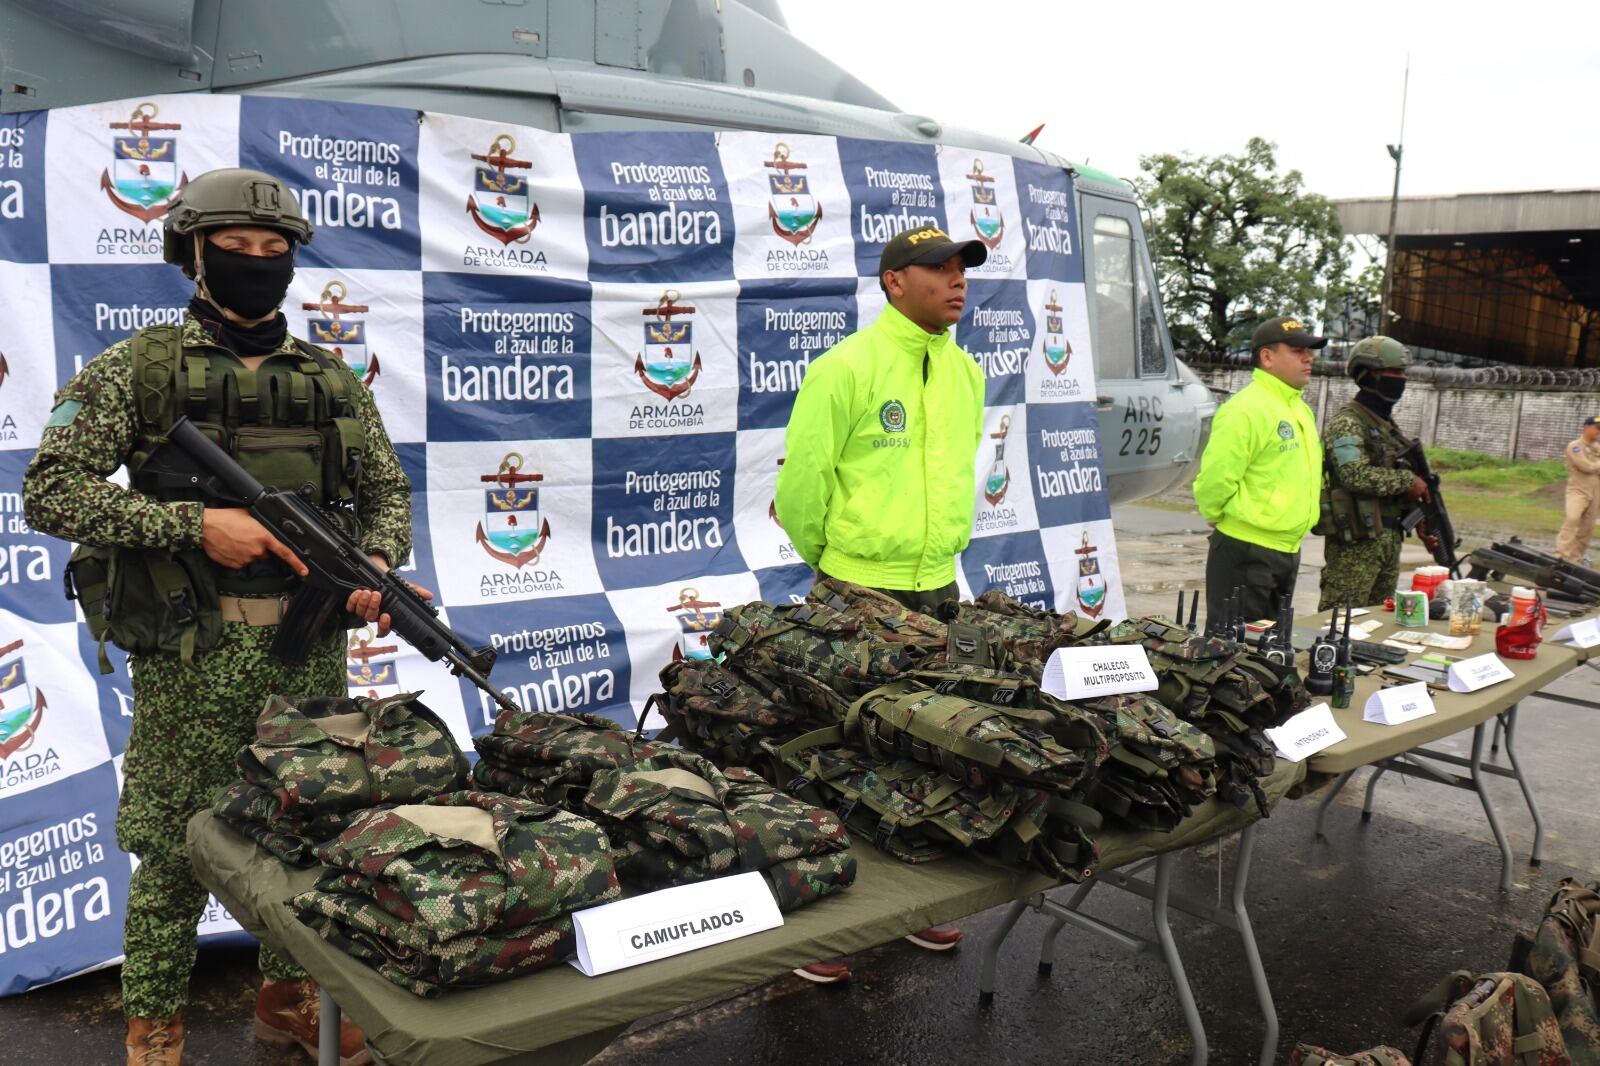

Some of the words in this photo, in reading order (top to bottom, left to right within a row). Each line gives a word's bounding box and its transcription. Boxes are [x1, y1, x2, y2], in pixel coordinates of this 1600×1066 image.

[279, 130, 400, 166] Protegemos
[8, 150, 24, 168] la
[315, 162, 328, 179] el
[331, 165, 361, 184] azul
[365, 165, 383, 187] de
[387, 166, 400, 187] la
[611, 161, 710, 189] Protegemos
[864, 166, 934, 193] Protegemos
[649, 186, 659, 201] el
[660, 186, 686, 201] azul
[688, 186, 704, 201] de
[706, 186, 717, 201] la
[892, 191, 899, 206] el
[900, 192, 917, 207] azul
[917, 191, 928, 208] de
[928, 191, 936, 208] la
[289, 182, 402, 230] ndera
[600, 201, 721, 247] bandera
[97, 228, 163, 243] ARMA
[97, 244, 115, 254] DE
[119, 244, 163, 254] COLO
[464, 244, 548, 265] ARMADA
[766, 250, 829, 263] ARMADA
[986, 254, 1012, 265] MADA
[463, 256, 481, 266] DE
[767, 263, 781, 271] DE
[783, 262, 830, 271] COLOMBIA
[96, 302, 184, 331] Protege
[461, 307, 574, 338] Protegemos
[765, 307, 846, 334] Protegemos
[973, 306, 1024, 330] Protegemos
[495, 336, 507, 354] el
[510, 336, 538, 354] azul
[541, 335, 558, 354] de
[562, 335, 573, 354] la
[789, 333, 799, 350] el
[801, 332, 822, 350] azul
[988, 329, 995, 343] el
[996, 329, 1008, 343] azul
[1008, 328, 1020, 342] de
[1020, 327, 1030, 339] la
[442, 355, 574, 401] bandera
[750, 350, 810, 393] band
[1041, 379, 1079, 390] ARMADA
[630, 404, 704, 420] ARMADA
[1124, 395, 1164, 423] ARC
[629, 419, 644, 430] DE
[646, 417, 704, 429] COLOMBIA
[1041, 429, 1096, 449] Protegemos
[1119, 426, 1162, 456] 225
[1060, 449, 1069, 462] el
[1070, 448, 1084, 461] azul
[625, 469, 721, 496] Protegemos
[1037, 461, 1102, 498] bandera
[653, 495, 664, 512] el
[666, 493, 691, 511] azul
[693, 492, 708, 509] de
[710, 491, 720, 507] la
[976, 508, 1016, 522] ARMADA
[607, 511, 724, 558] bandera
[976, 523, 985, 532] DE
[985, 520, 1018, 530] COLOMBIA
[480, 570, 562, 588] ARMADA
[984, 560, 1041, 584] Protegemos
[480, 587, 498, 597] DE
[500, 582, 564, 596] COLOMBIA
[1005, 582, 1014, 597] el
[1014, 581, 1028, 596] azul
[1028, 579, 1038, 594] de
[1037, 578, 1046, 592] la
[490, 621, 606, 654] Protegemos
[529, 653, 542, 671] el
[545, 648, 574, 668] azul
[578, 643, 594, 662] de
[596, 641, 610, 659] la
[1092, 661, 1130, 673] CHALECOS
[1083, 671, 1145, 687] MULTIPROPOSITO
[1294, 727, 1330, 748] INTENDENCIA
[0, 812, 97, 870] egemos
[15, 854, 56, 889] azul
[60, 849, 83, 874] de
[86, 841, 105, 865] la
[0, 876, 111, 953] dera
[630, 909, 745, 950] CAMUFLADOS
